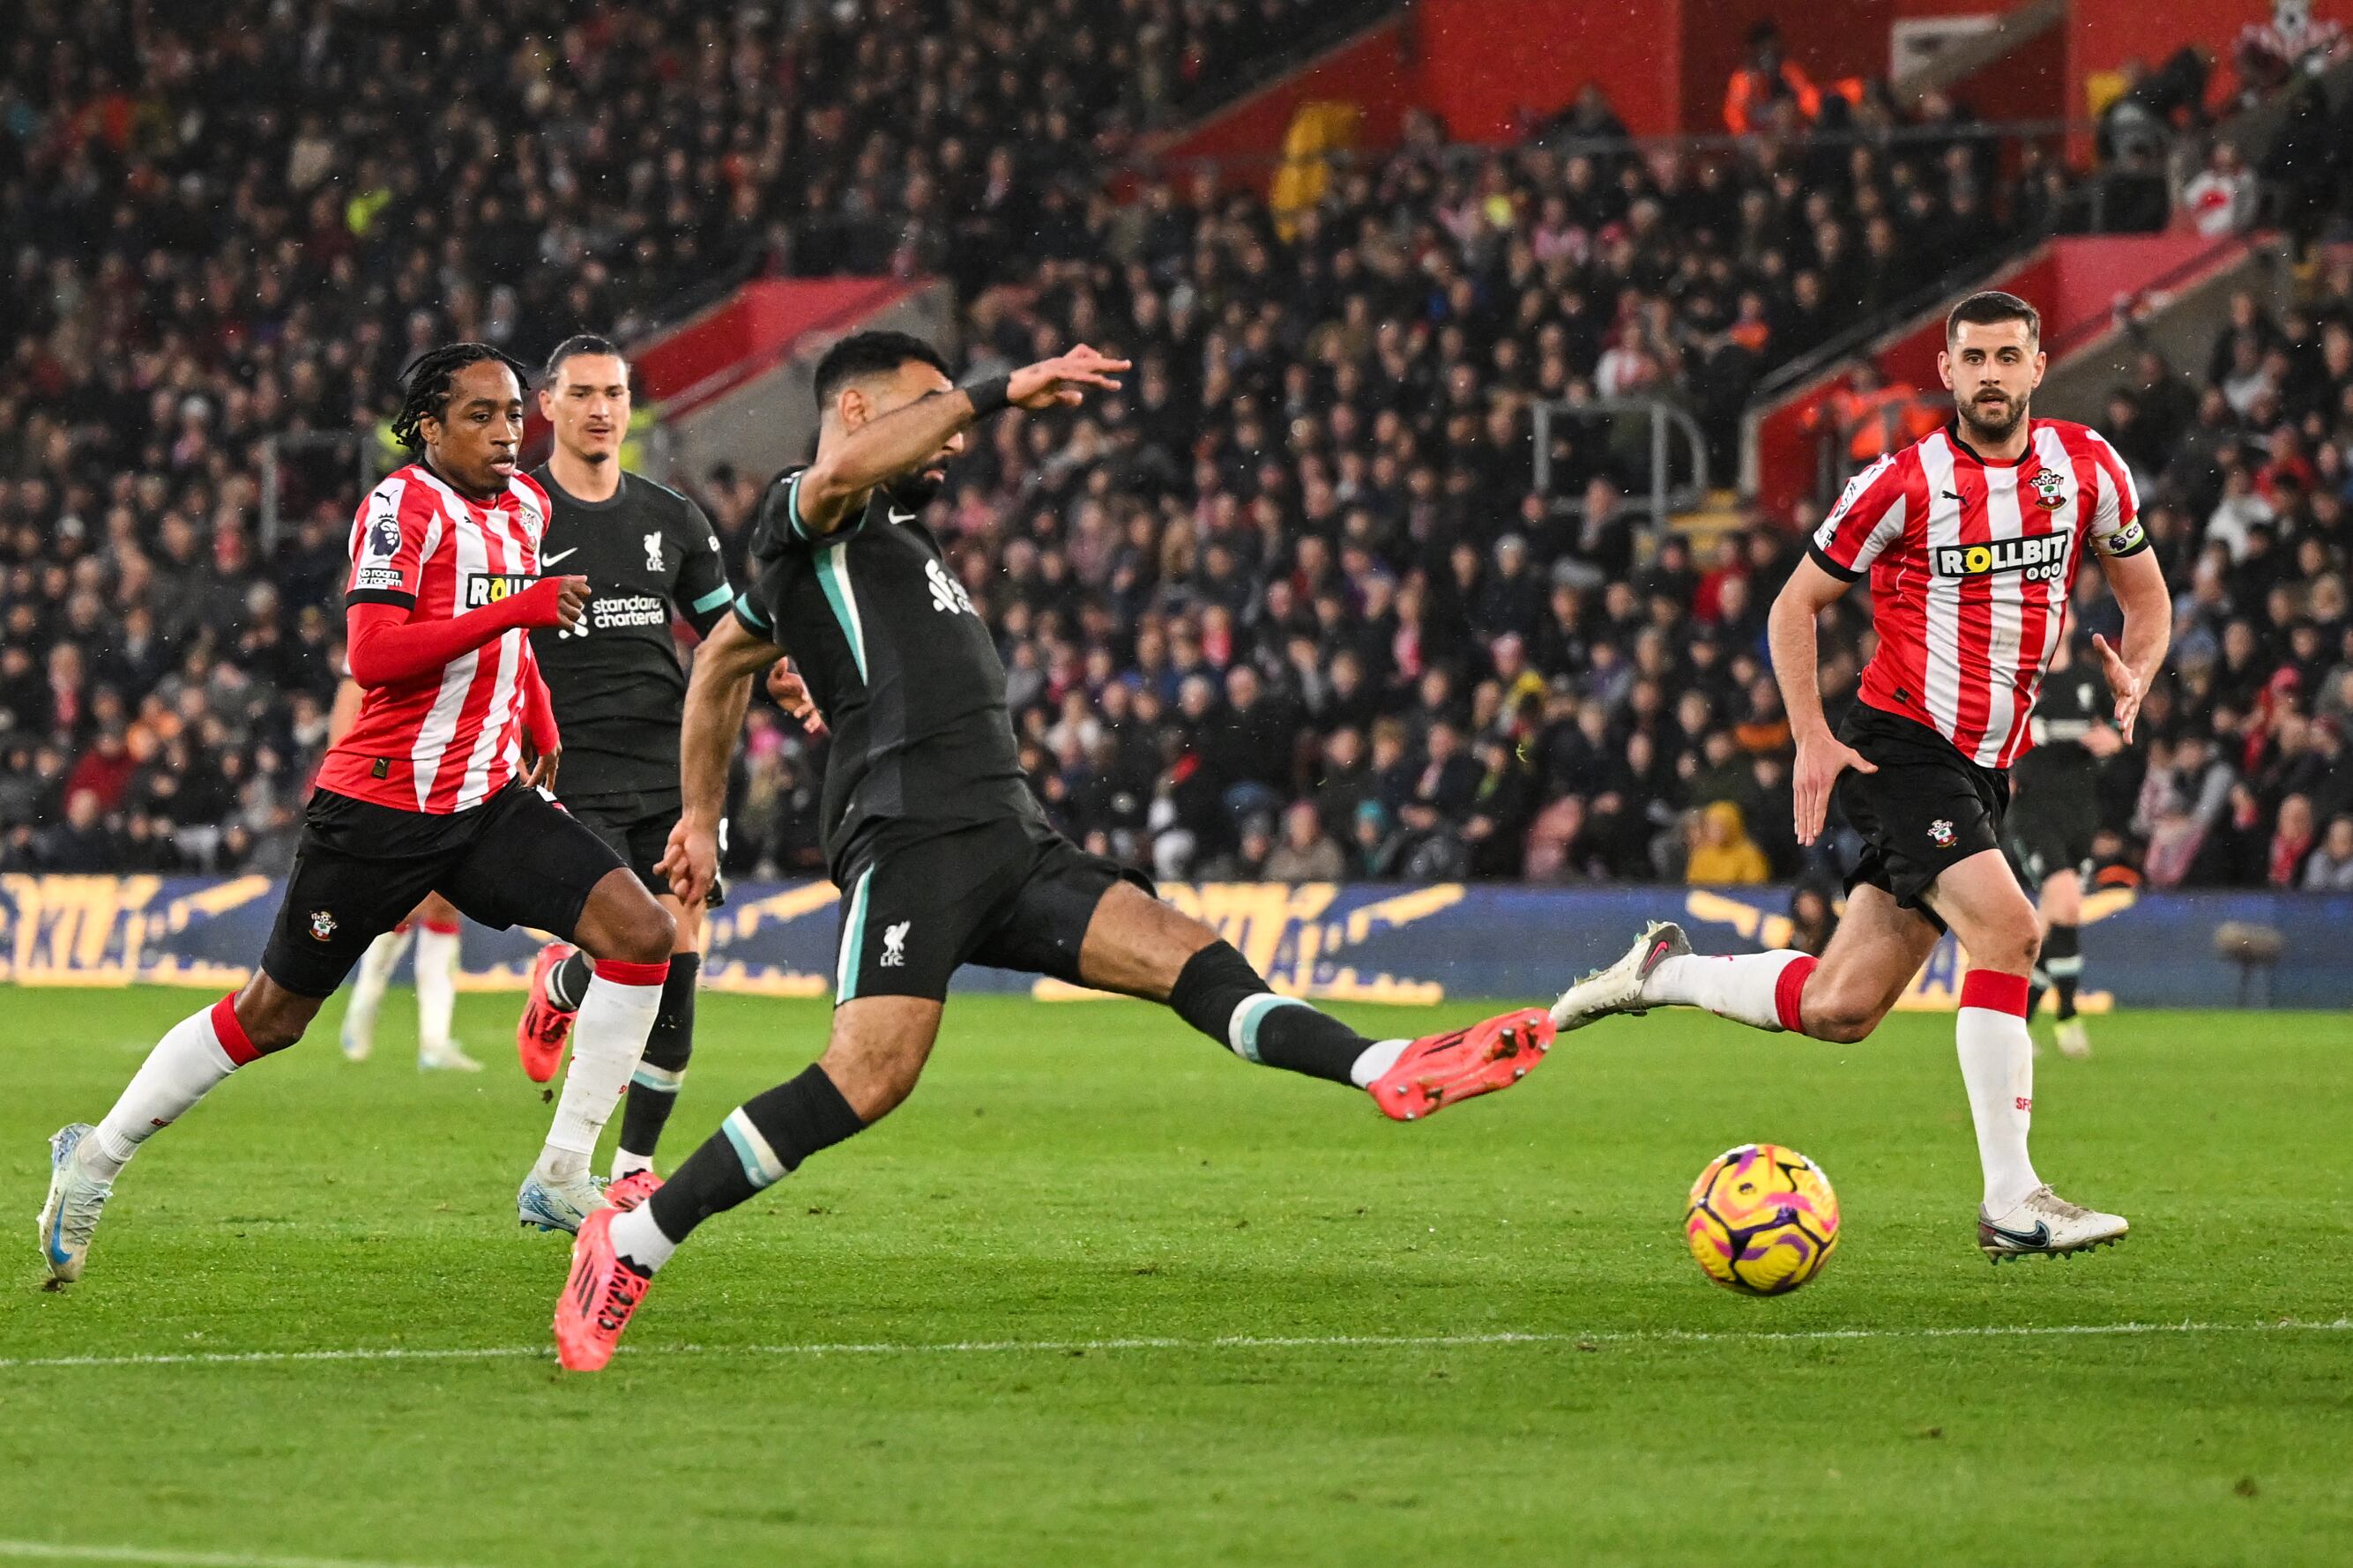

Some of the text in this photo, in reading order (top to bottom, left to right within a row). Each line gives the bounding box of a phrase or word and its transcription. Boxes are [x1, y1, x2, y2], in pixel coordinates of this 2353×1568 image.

[1940, 534, 2066, 574] ROLLBIT
[360, 568, 398, 579] No room
[470, 577, 539, 606] ROLL
[594, 608, 664, 628] chartered
